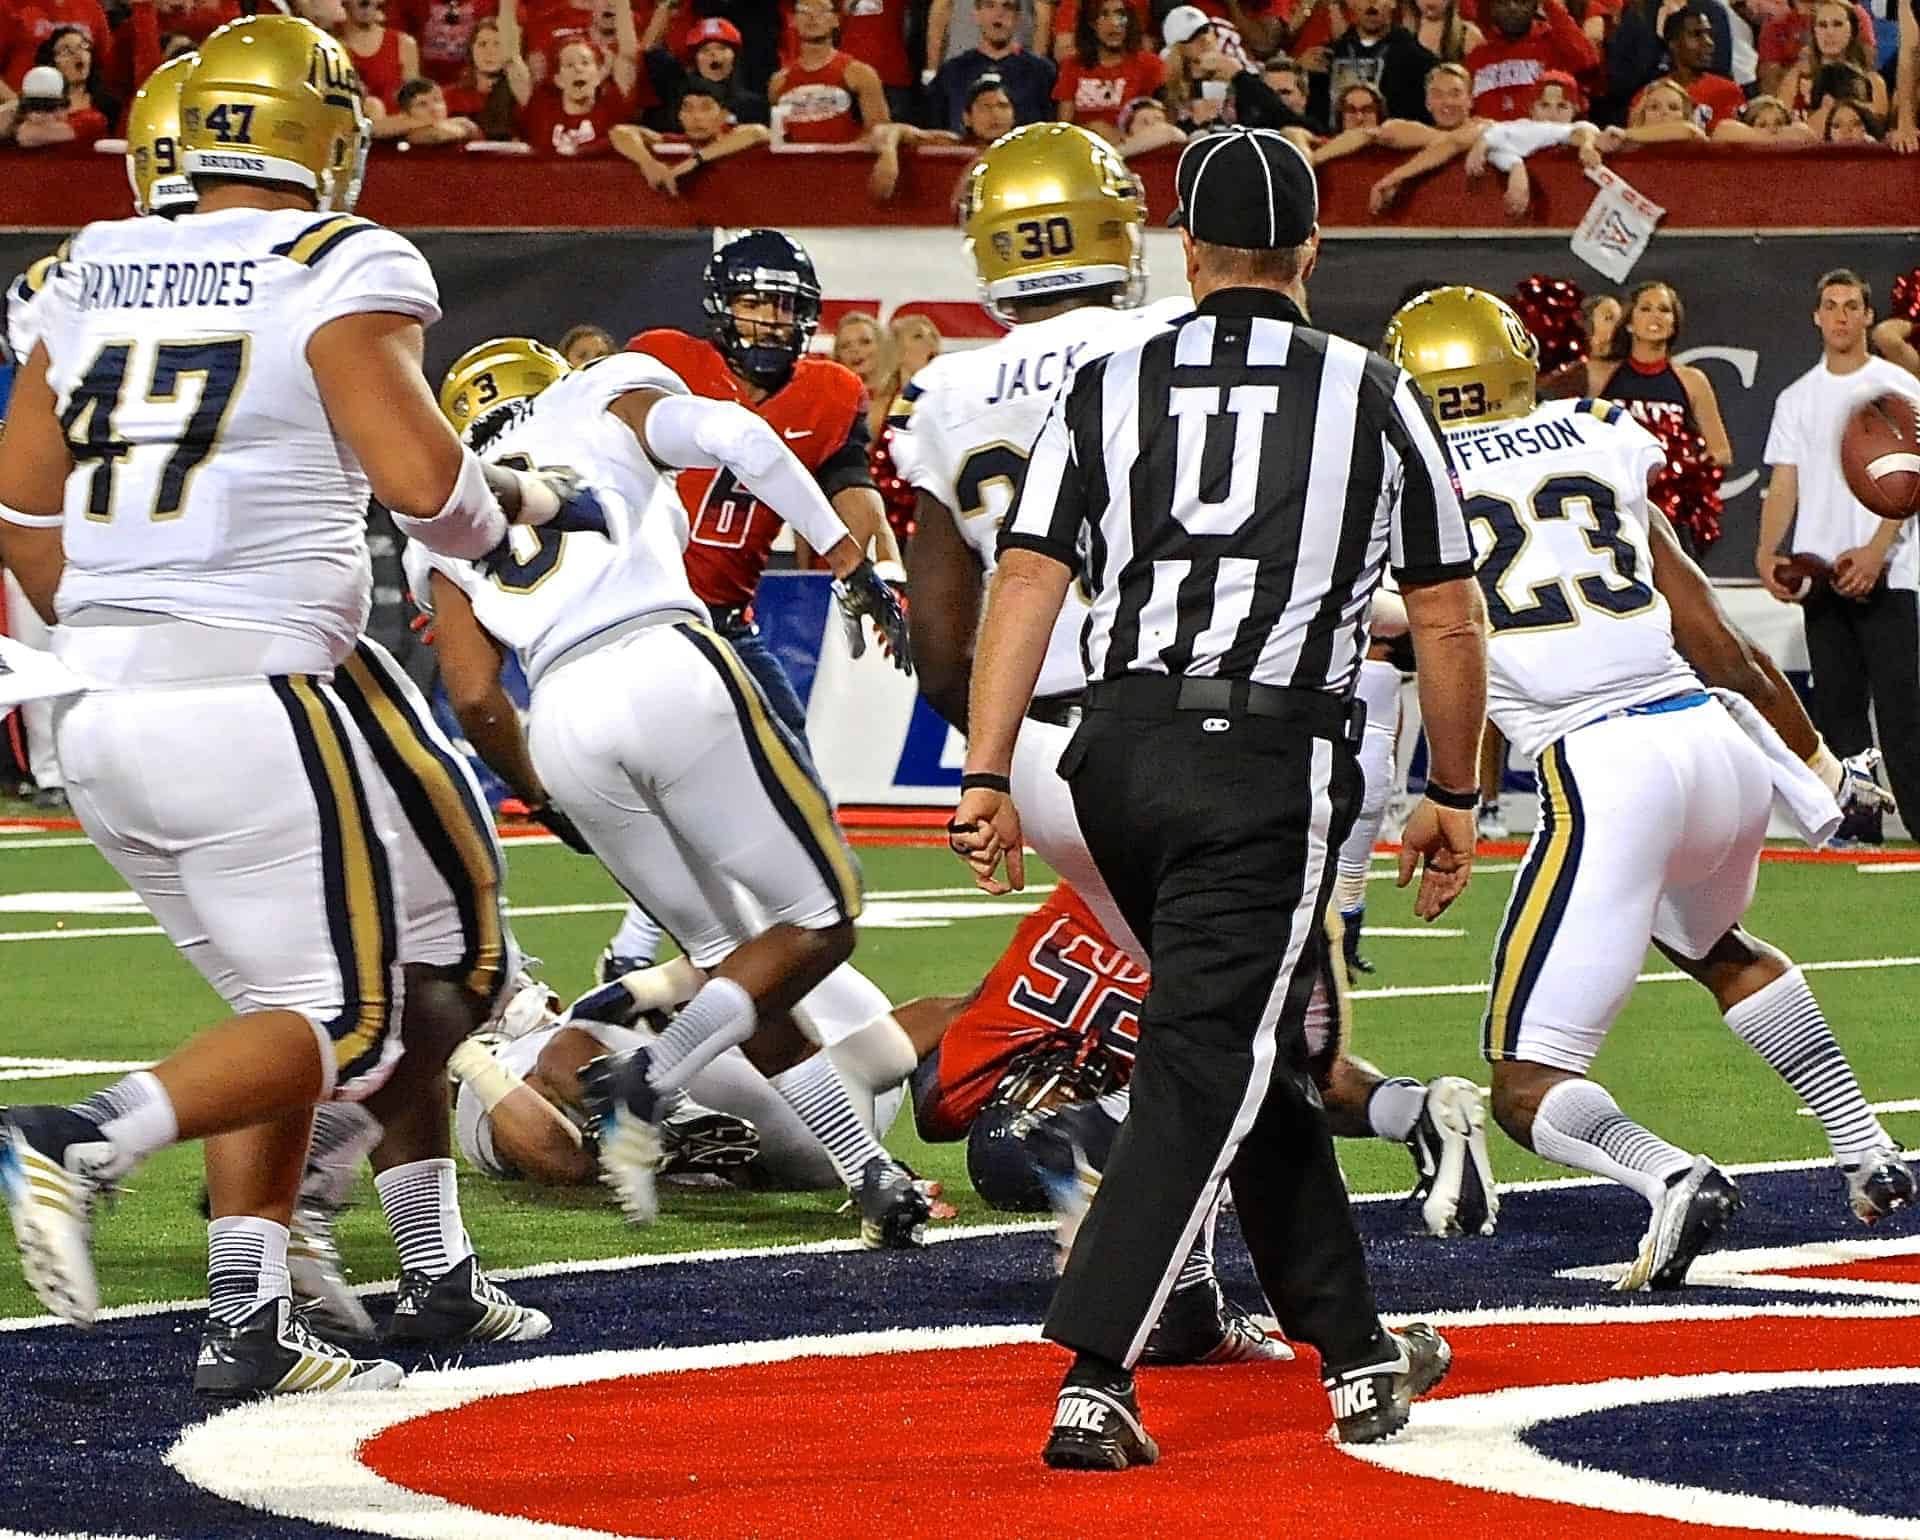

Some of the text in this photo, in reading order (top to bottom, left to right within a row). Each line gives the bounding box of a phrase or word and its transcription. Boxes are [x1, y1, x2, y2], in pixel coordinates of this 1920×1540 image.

[206, 103, 255, 143] 47
[155, 136, 182, 175] 9
[200, 154, 264, 172] BRUINS
[1016, 216, 1075, 260] 30
[472, 373, 499, 405] 3
[984, 340, 1089, 405] JACK
[1437, 382, 1487, 421] 23
[59, 331, 254, 524] 47
[1168, 385, 1280, 536] U
[1461, 470, 1658, 636] 23
